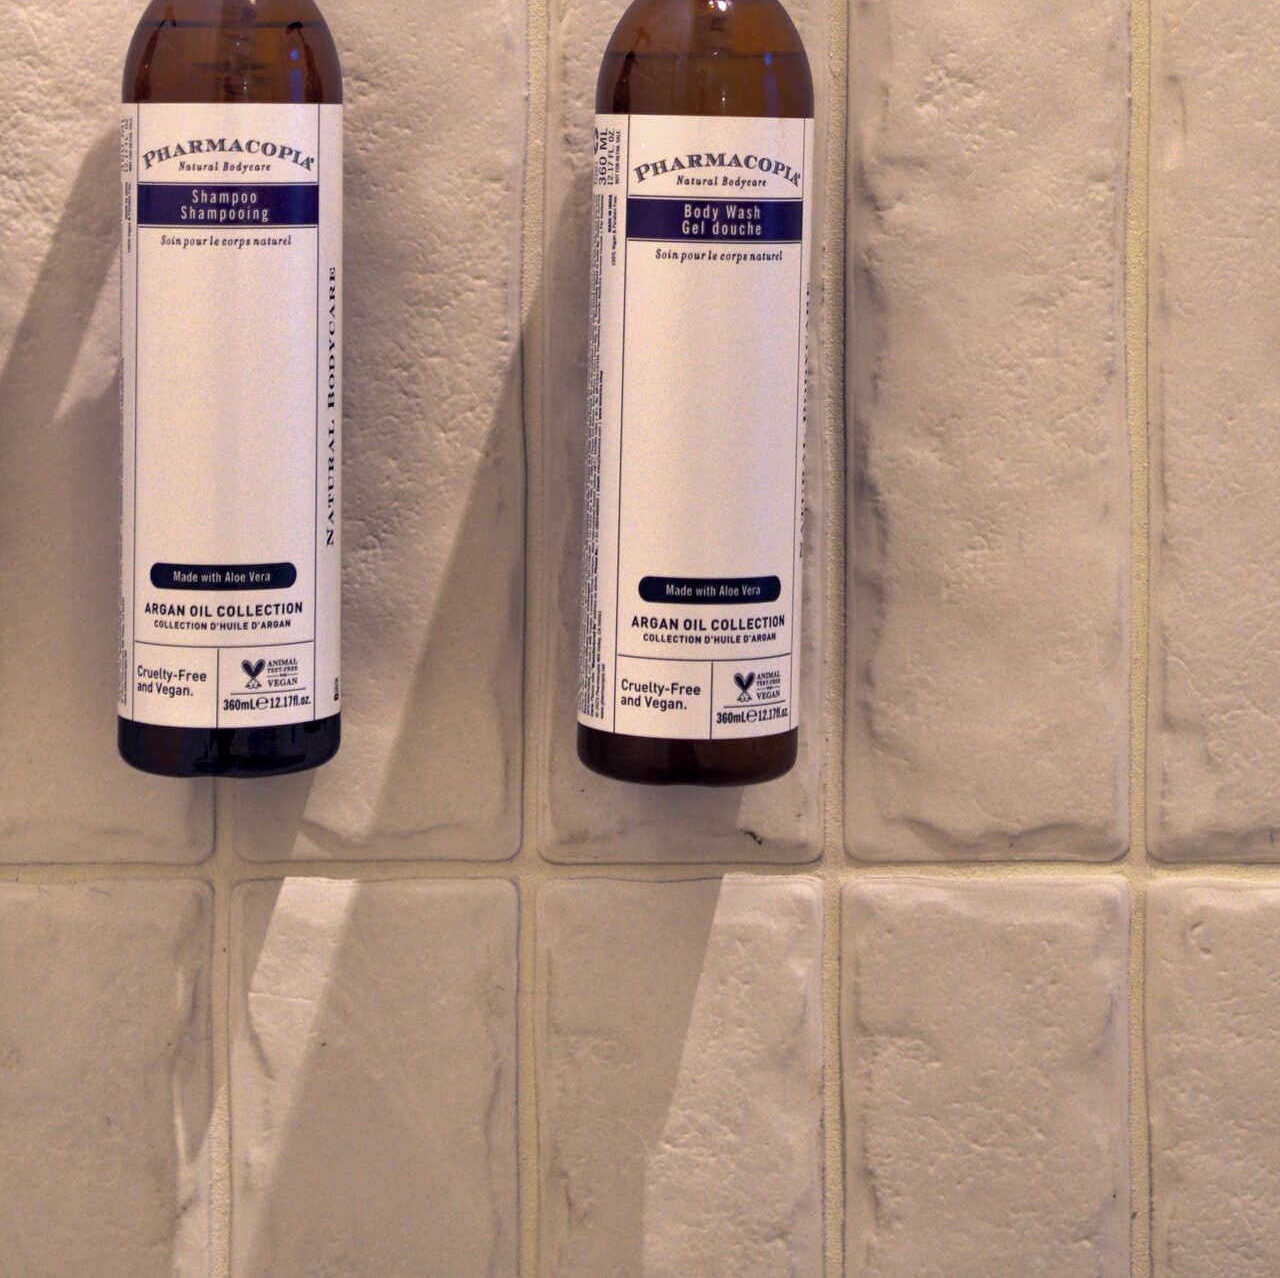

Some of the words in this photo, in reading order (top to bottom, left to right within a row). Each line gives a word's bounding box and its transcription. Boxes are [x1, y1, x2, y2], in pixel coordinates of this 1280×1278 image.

[599, 128, 608, 150] ML
[142, 138, 312, 171] PHARMACOPIA
[179, 162, 218, 171] Natural
[223, 162, 270, 174] Bodycare
[599, 156, 607, 185] 360
[634, 153, 799, 187] PHARMACOPIA
[677, 176, 718, 186] Natural
[722, 176, 766, 189] Bodycare
[192, 190, 256, 205] Shampoo
[181, 206, 269, 222] Shampooing
[684, 204, 718, 221] Body
[726, 205, 760, 219] Wash
[682, 221, 704, 234] Gel
[712, 222, 761, 235] douche
[161, 236, 181, 245] Soin
[183, 237, 207, 249] pour
[210, 236, 219, 246] le
[221, 238, 250, 249] corps
[253, 235, 292, 246] naturel
[656, 249, 678, 259] Soin
[680, 251, 705, 262] pour
[708, 249, 717, 260] le
[719, 252, 747, 263] corps
[749, 251, 782, 261] naturel
[173, 571, 197, 582] Made
[201, 572, 221, 582] with
[225, 572, 245, 582] Aloe
[249, 571, 270, 582] Vera
[666, 584, 692, 596] Made
[696, 585, 715, 597] with
[719, 585, 739, 596] Aloe
[742, 584, 760, 595] Vera
[145, 603, 185, 616] ARGAN
[190, 605, 212, 617] OIL
[217, 602, 302, 617] COLLECTION
[154, 620, 207, 630] COLLECTION
[210, 622, 248, 631] D'HUILE
[252, 620, 291, 629] D'ARGAN
[631, 616, 678, 630] ARGAN
[683, 618, 706, 631] OIL
[711, 614, 785, 631] COLLECTION
[643, 633, 701, 644] COLLECTION
[705, 635, 740, 644] D'HUILE
[743, 633, 776, 643] D'ARGAN
[267, 658, 297, 667] ANIMAL
[137, 666, 207, 683] Cruelty-Free
[757, 671, 780, 679] ANIMAL
[137, 681, 153, 693] and
[156, 684, 193, 698] Vegan.
[267, 678, 297, 687] VEGAN
[621, 679, 700, 696] Cruelty-Free
[756, 690, 780, 699] VEGAN
[621, 695, 641, 706] and
[644, 697, 686, 712] Vegan.
